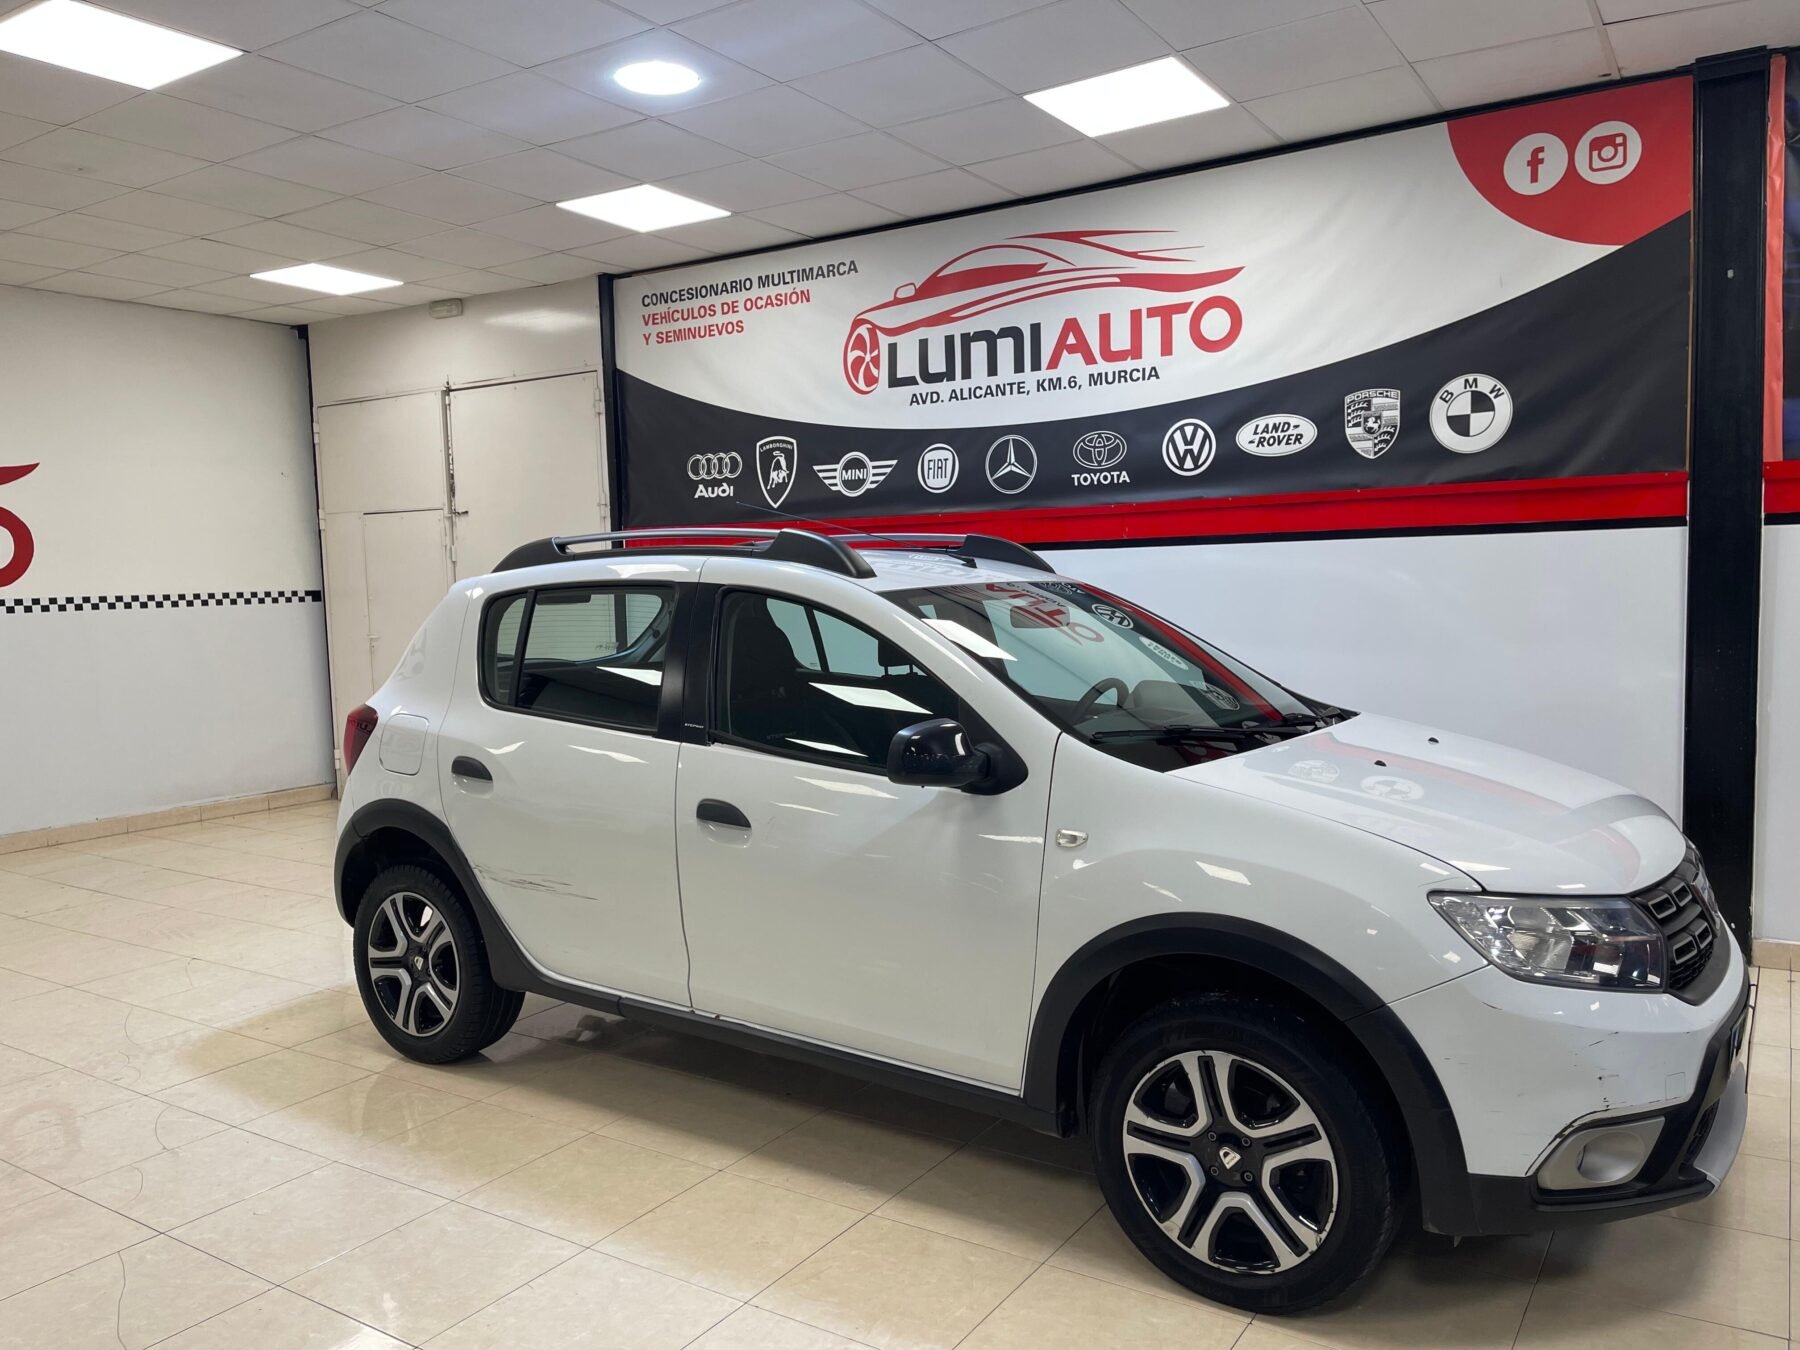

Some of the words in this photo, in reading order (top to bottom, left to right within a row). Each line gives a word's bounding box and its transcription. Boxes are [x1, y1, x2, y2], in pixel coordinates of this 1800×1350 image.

[641, 277, 753, 308] CONCESIONARIO
[757, 260, 859, 289] MULTIMARCA
[641, 302, 717, 327] VEHÍCULOS
[721, 300, 739, 316] DE
[743, 287, 811, 312] OCASIÓN
[642, 332, 652, 346] Y
[655, 319, 745, 345] SEMINUEVOS
[909, 391, 945, 407] AVD.
[948, 381, 1031, 403] ALICANTE,
[1035, 375, 1083, 394] KM.6,
[1088, 366, 1160, 387] MURCIA
[1438, 377, 1505, 404] BMW
[1346, 389, 1399, 405] PORSCHE
[1252, 423, 1291, 436] LAND
[760, 442, 793, 453] LAMBORGHINI
[1255, 433, 1304, 448] ROVER
[841, 468, 867, 481] MINI
[926, 457, 949, 480] FIAT
[1071, 470, 1130, 487] TOYOTA
[694, 482, 734, 499] Audi
